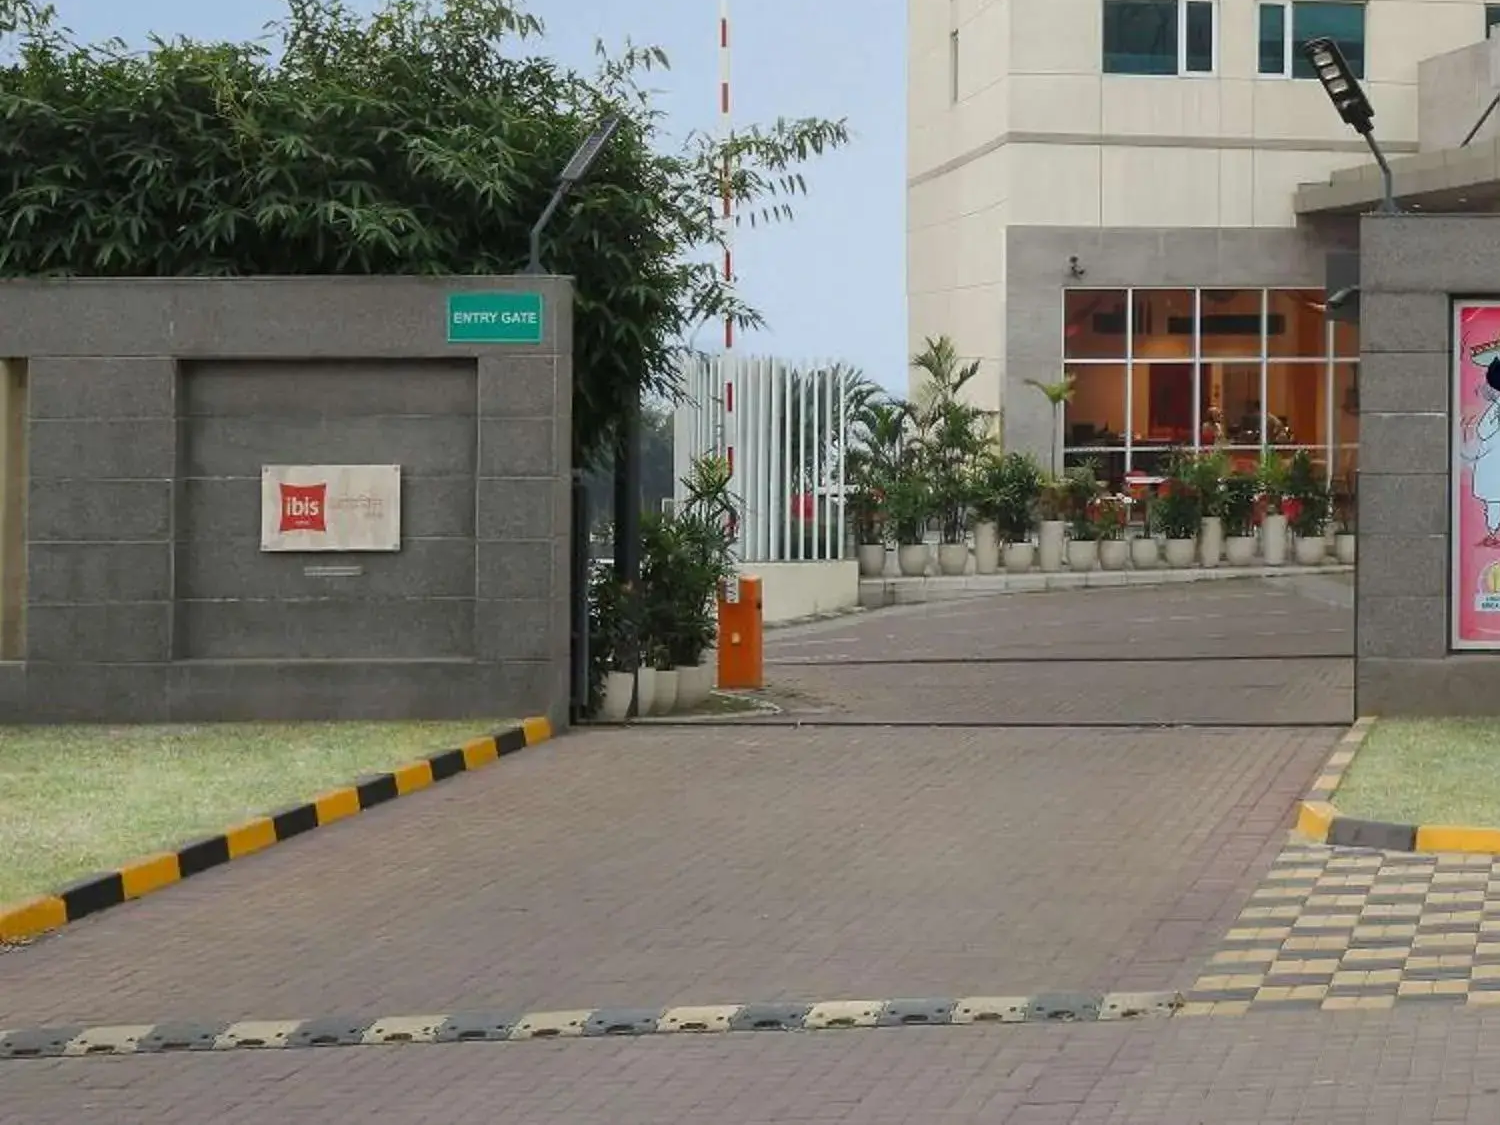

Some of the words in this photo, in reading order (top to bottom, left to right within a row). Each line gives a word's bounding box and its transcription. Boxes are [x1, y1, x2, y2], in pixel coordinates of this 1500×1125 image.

[453, 311, 498, 324] ENTRY
[501, 311, 538, 324] GATE
[286, 496, 320, 516] ibis
